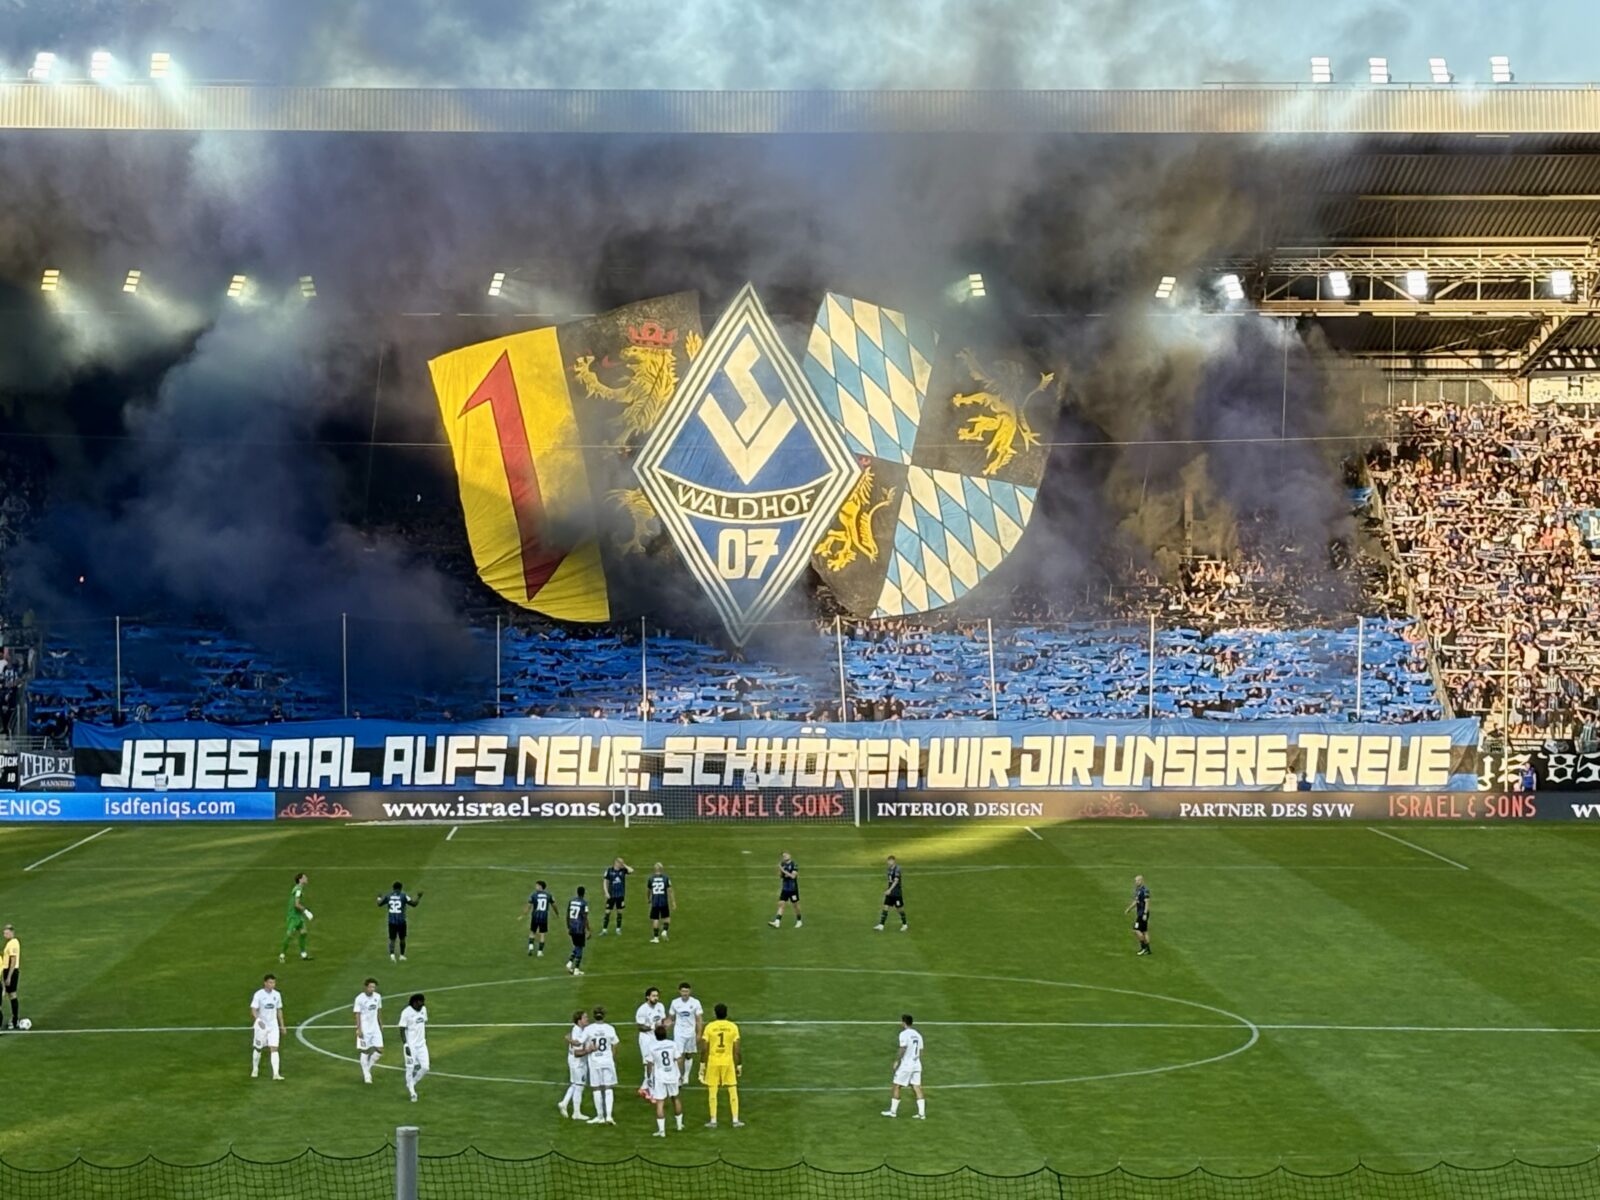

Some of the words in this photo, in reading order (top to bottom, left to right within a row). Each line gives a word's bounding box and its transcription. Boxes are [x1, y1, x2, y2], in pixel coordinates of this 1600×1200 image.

[677, 484, 815, 520] WALDHOF
[718, 528, 780, 580] 07
[21, 752, 55, 778] THE
[101, 738, 259, 789] JEDES
[268, 736, 370, 788] MAL
[383, 735, 508, 786] AUFS
[517, 735, 651, 791] NEUE,
[662, 726, 920, 788] SCHWÖREN
[927, 737, 1012, 788] WIR
[1021, 735, 1095, 787] DIR
[1101, 735, 1288, 787] UNSERE
[1298, 735, 1452, 786] TREUE
[104, 798, 236, 818] isdfeniqs.com
[383, 797, 664, 818] www.israel-sons.com
[697, 794, 770, 817] ISRAEL
[792, 794, 845, 817] SONS
[877, 802, 970, 817] INTERIOR
[973, 802, 1044, 817] DESIGN
[1180, 802, 1266, 818] PARTNER
[1270, 802, 1308, 818] DES
[1312, 802, 1355, 818] SVW
[1389, 795, 1462, 818] ISRAEL
[1484, 796, 1537, 818] SONS
[652, 882, 664, 894] 22
[389, 900, 402, 913] 32
[537, 899, 547, 911] 10
[570, 905, 580, 919] 27
[717, 1032, 725, 1048] 1
[661, 1050, 671, 1066] 8
